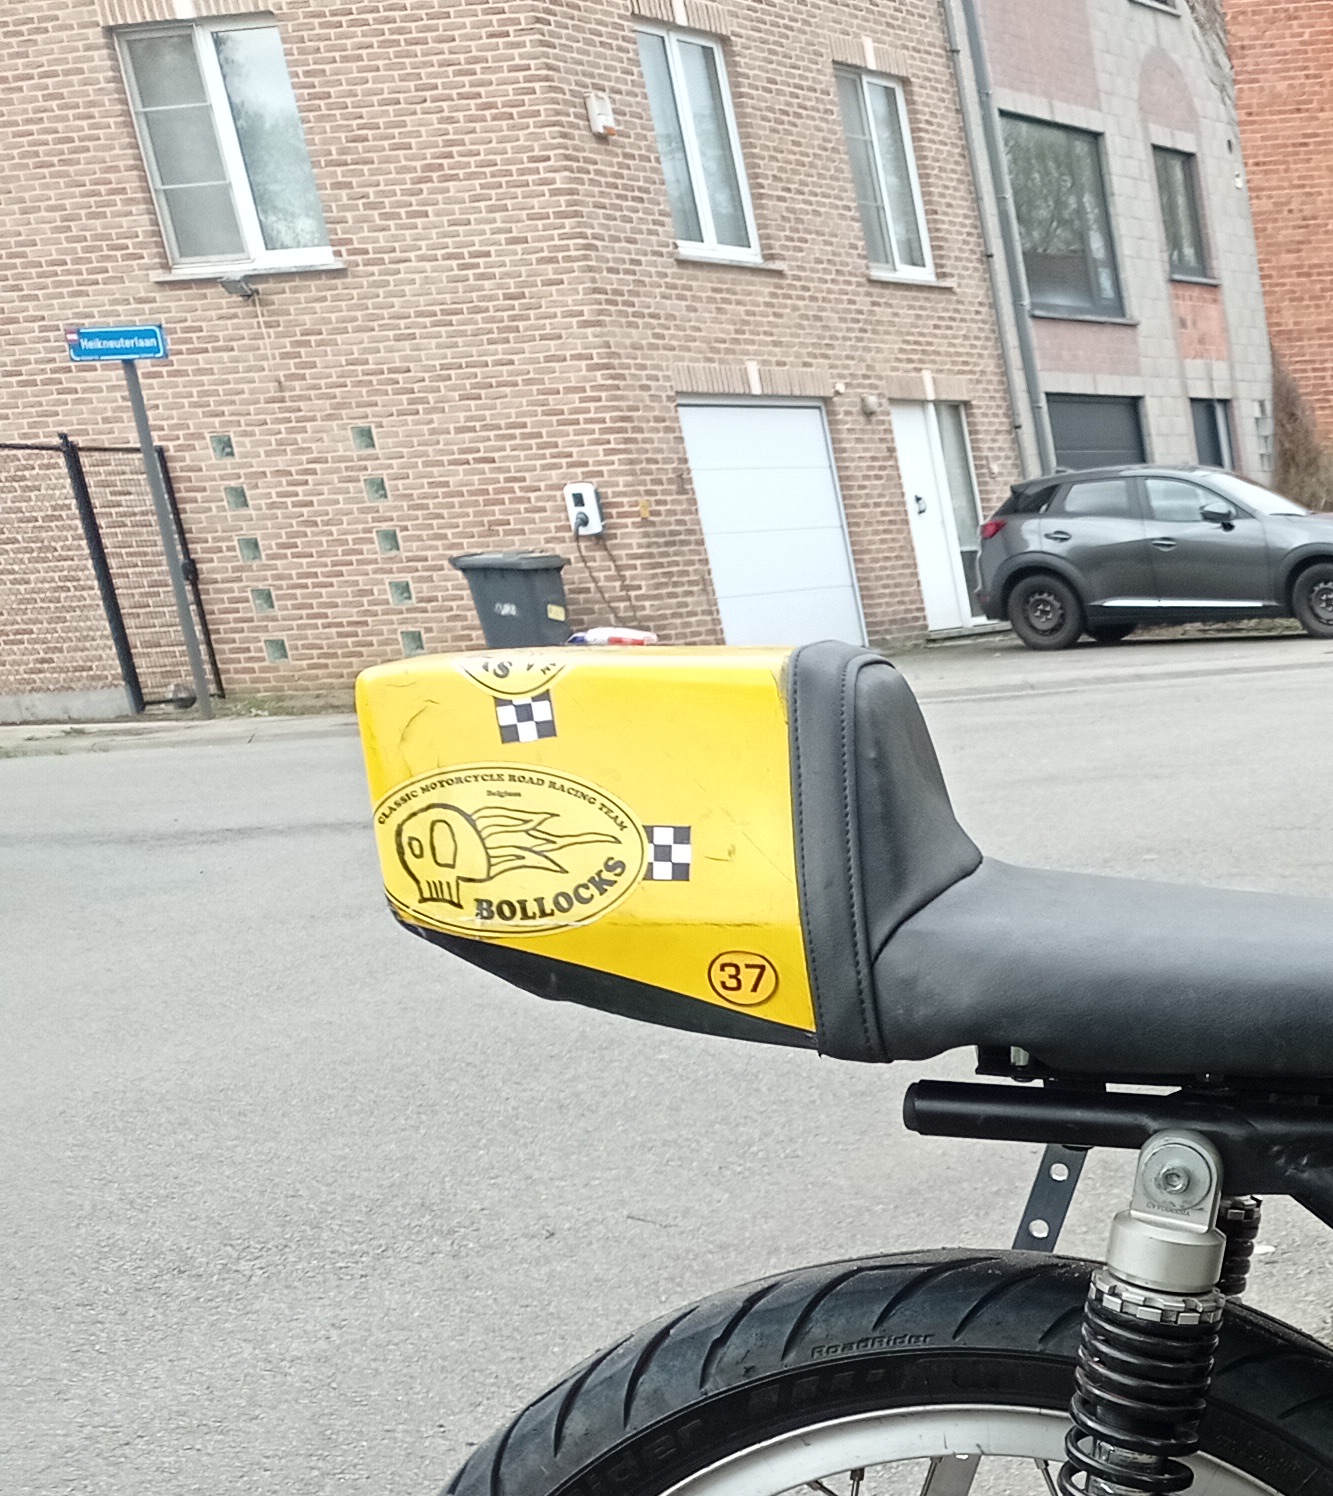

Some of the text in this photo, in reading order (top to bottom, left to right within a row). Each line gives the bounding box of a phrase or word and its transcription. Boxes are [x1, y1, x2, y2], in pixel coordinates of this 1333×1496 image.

[378, 773, 629, 832] CLASSIC MOTORCYCLE ROAD RACING TEAM
[486, 789, 522, 798] Belgium
[474, 856, 627, 921] BOLLOCKS
[719, 962, 768, 994] 37
